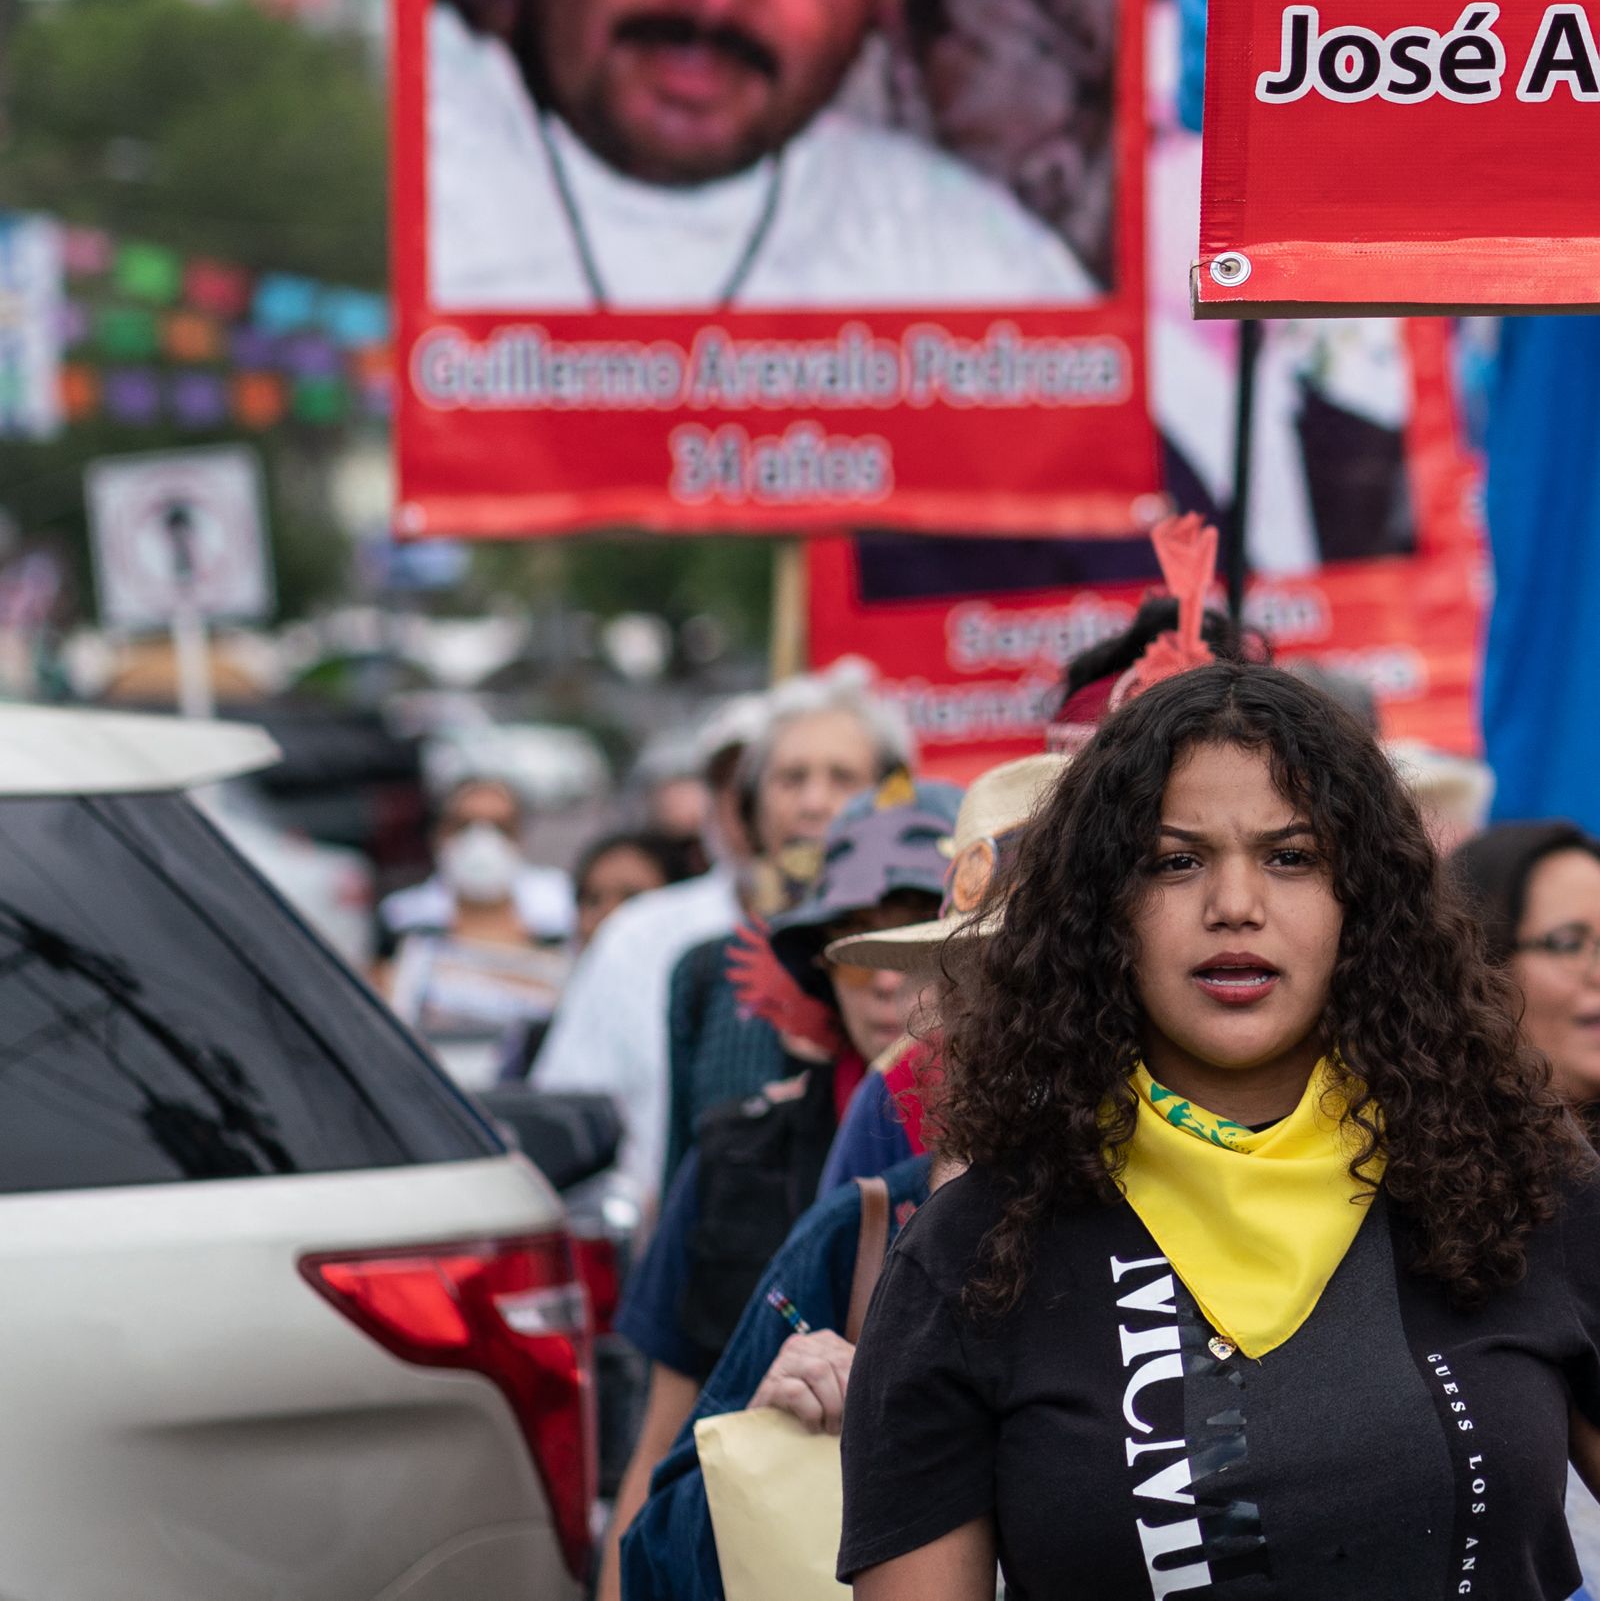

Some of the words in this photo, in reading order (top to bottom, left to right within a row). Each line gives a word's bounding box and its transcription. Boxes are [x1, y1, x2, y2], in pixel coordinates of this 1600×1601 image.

[1262, 3, 1496, 102] José
[411, 326, 684, 409] Guillermo
[671, 424, 747, 504] 34
[752, 422, 892, 504] años
[1427, 1352, 1473, 1432] GUESS
[1468, 1454, 1486, 1515] LOS
